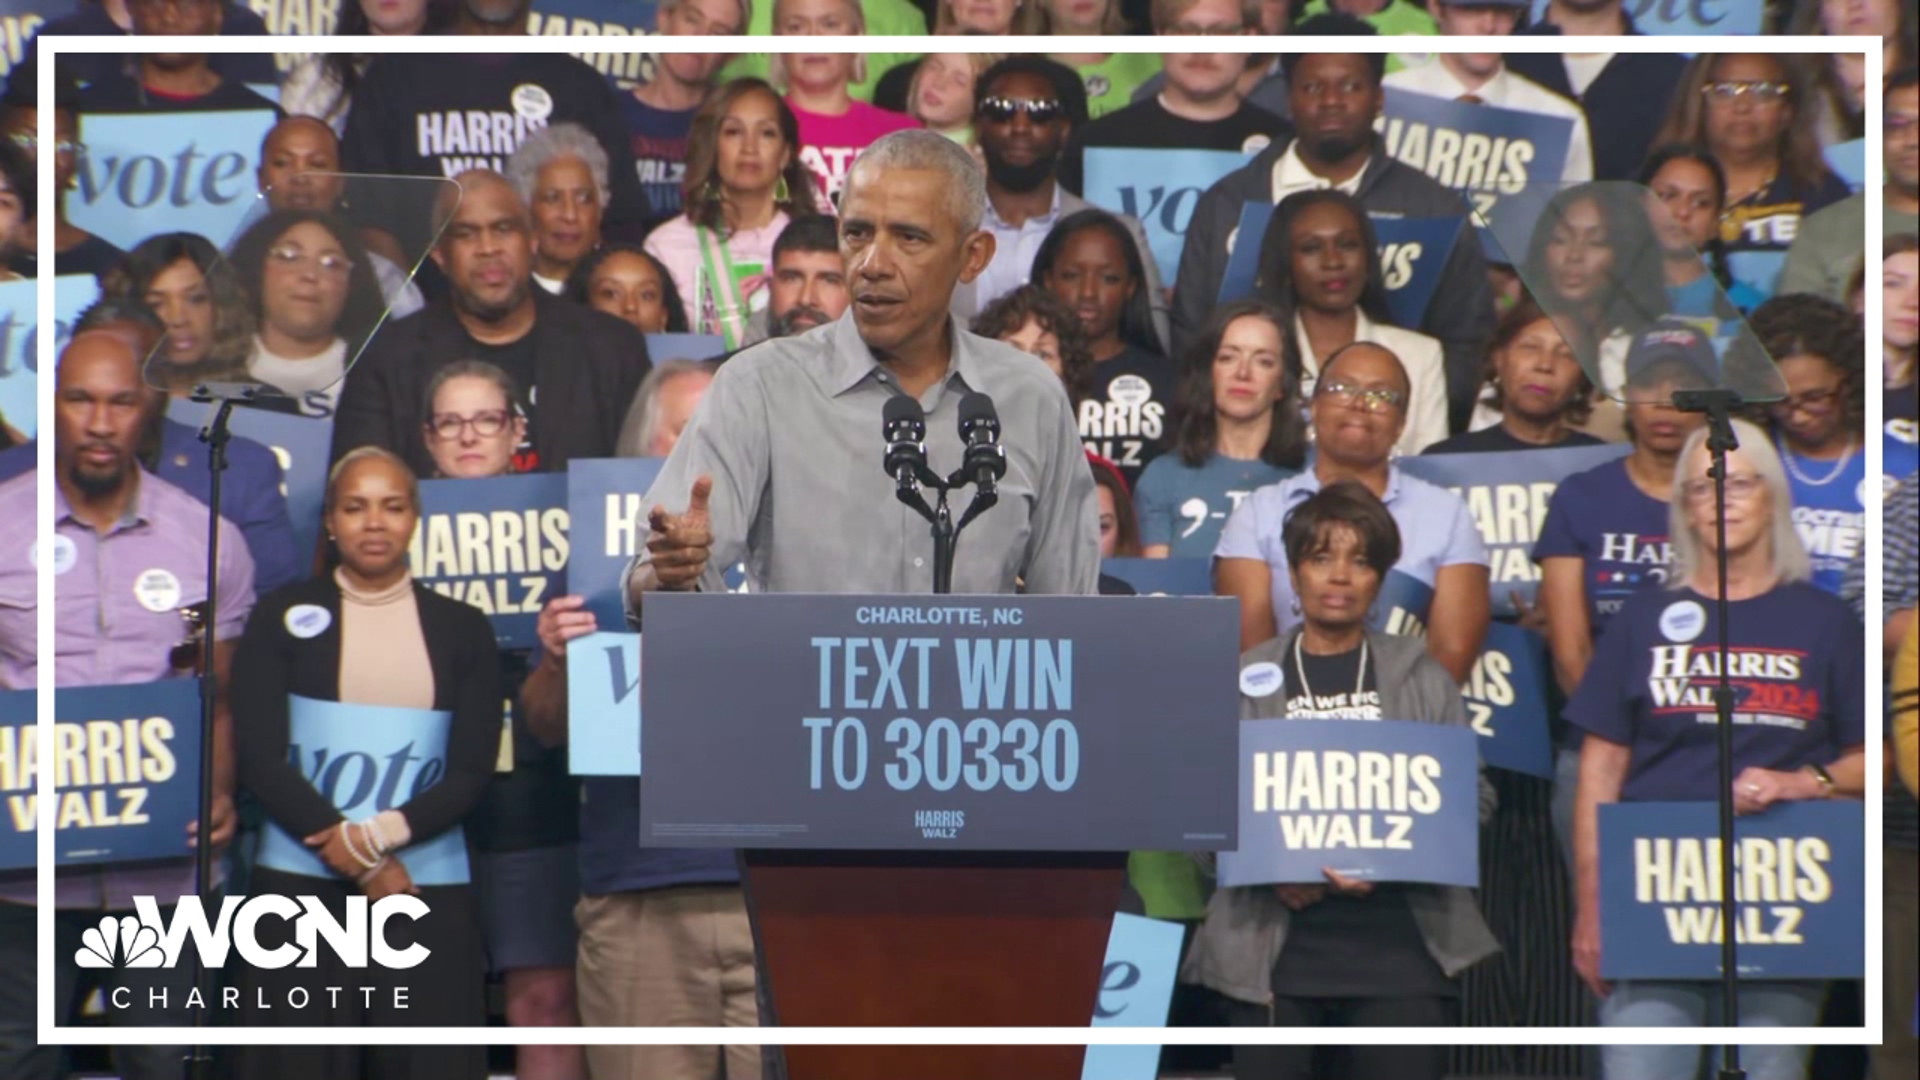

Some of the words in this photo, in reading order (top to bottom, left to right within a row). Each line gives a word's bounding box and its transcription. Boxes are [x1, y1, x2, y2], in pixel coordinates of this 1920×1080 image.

[77, 140, 249, 209] vote
[855, 607, 988, 627] CHARLOTTE,
[993, 607, 1023, 625] NC
[811, 637, 940, 709] TEXT
[954, 638, 1073, 710] WIN
[1649, 677, 1738, 708] WAL
[802, 717, 869, 790] TO
[884, 717, 1080, 791] 30330
[1253, 750, 1442, 815] HARRIS
[8, 786, 150, 833] WALZ
[915, 809, 965, 828] HARRIS
[922, 829, 957, 839] WALZ
[1280, 814, 1413, 850] WALZ
[1634, 836, 1832, 904] HARRIS
[1663, 905, 1804, 944] WALZ
